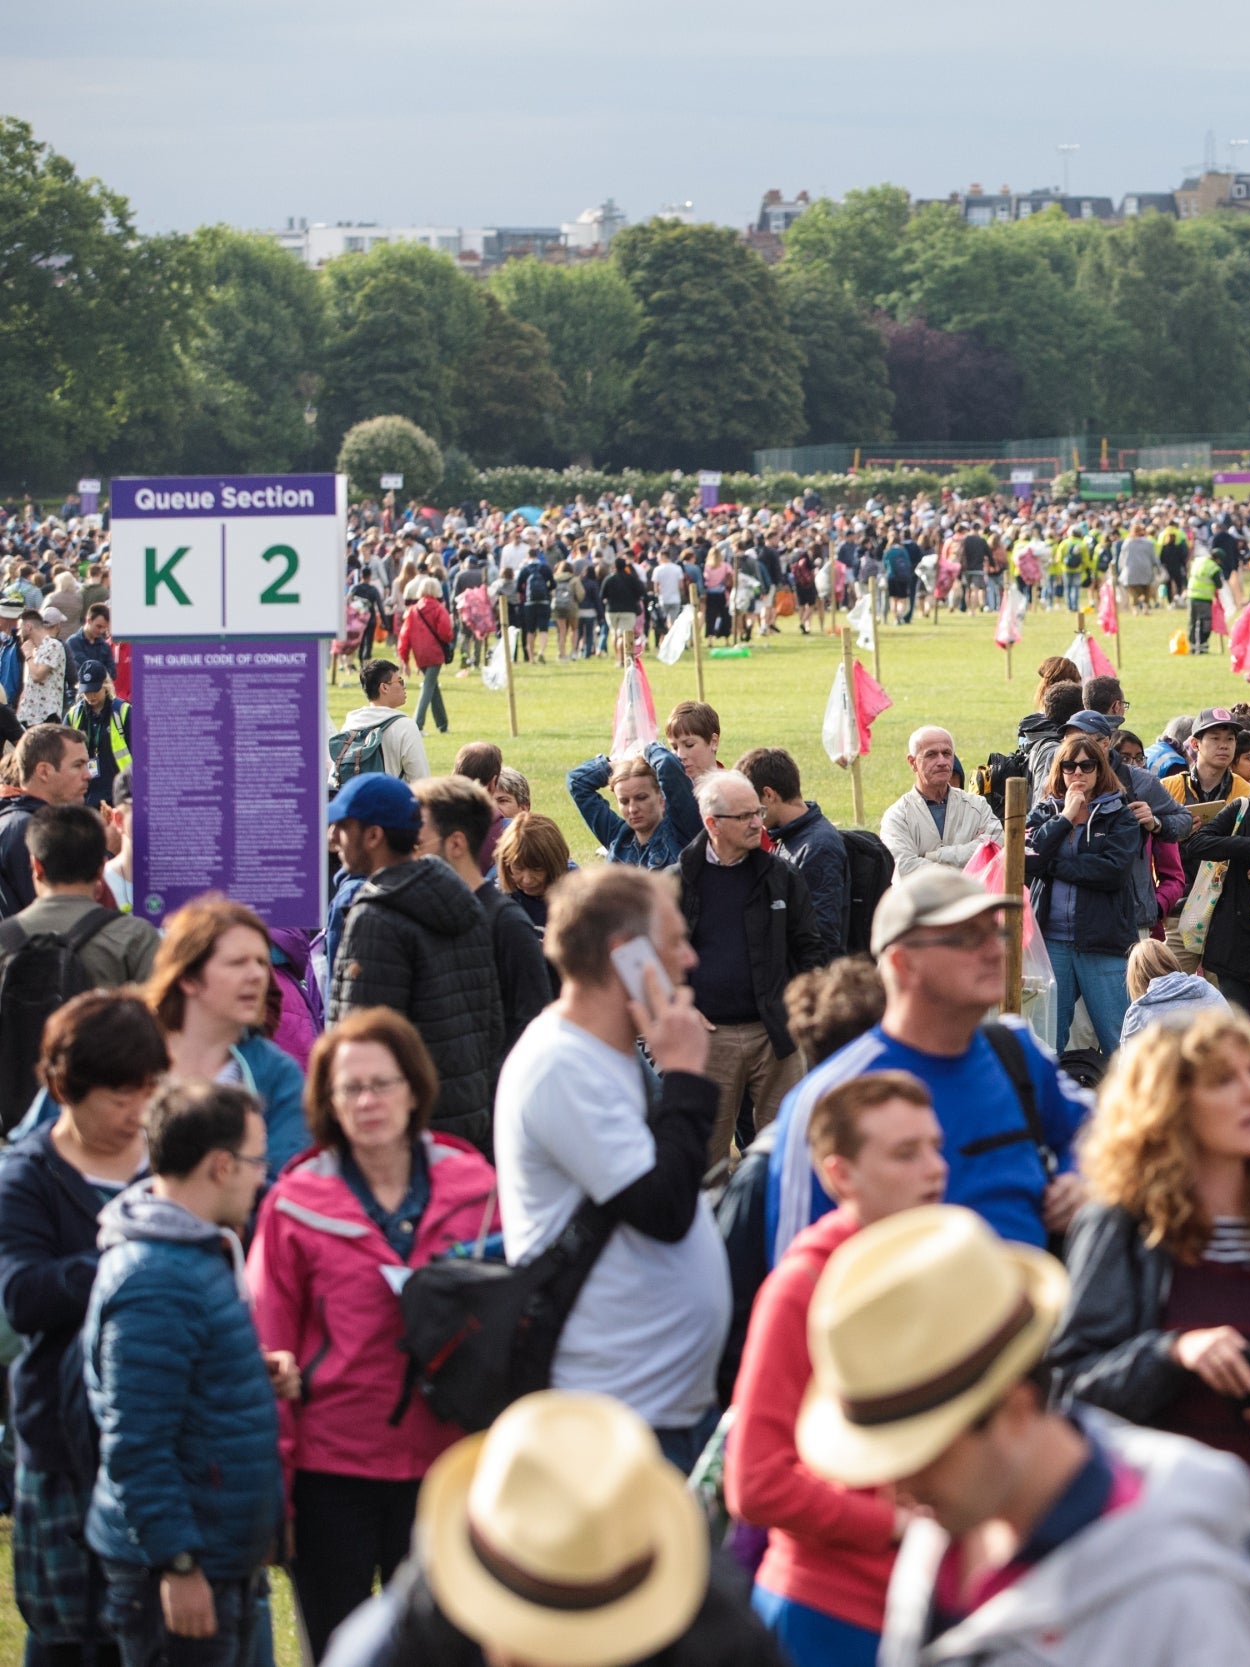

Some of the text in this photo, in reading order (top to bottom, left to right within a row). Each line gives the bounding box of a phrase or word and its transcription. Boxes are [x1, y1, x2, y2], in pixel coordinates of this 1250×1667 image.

[134, 485, 314, 510] Queue Section
[144, 544, 300, 606] K 2
[143, 653, 307, 666] THE QUEUE CODE OF CONDUCT
